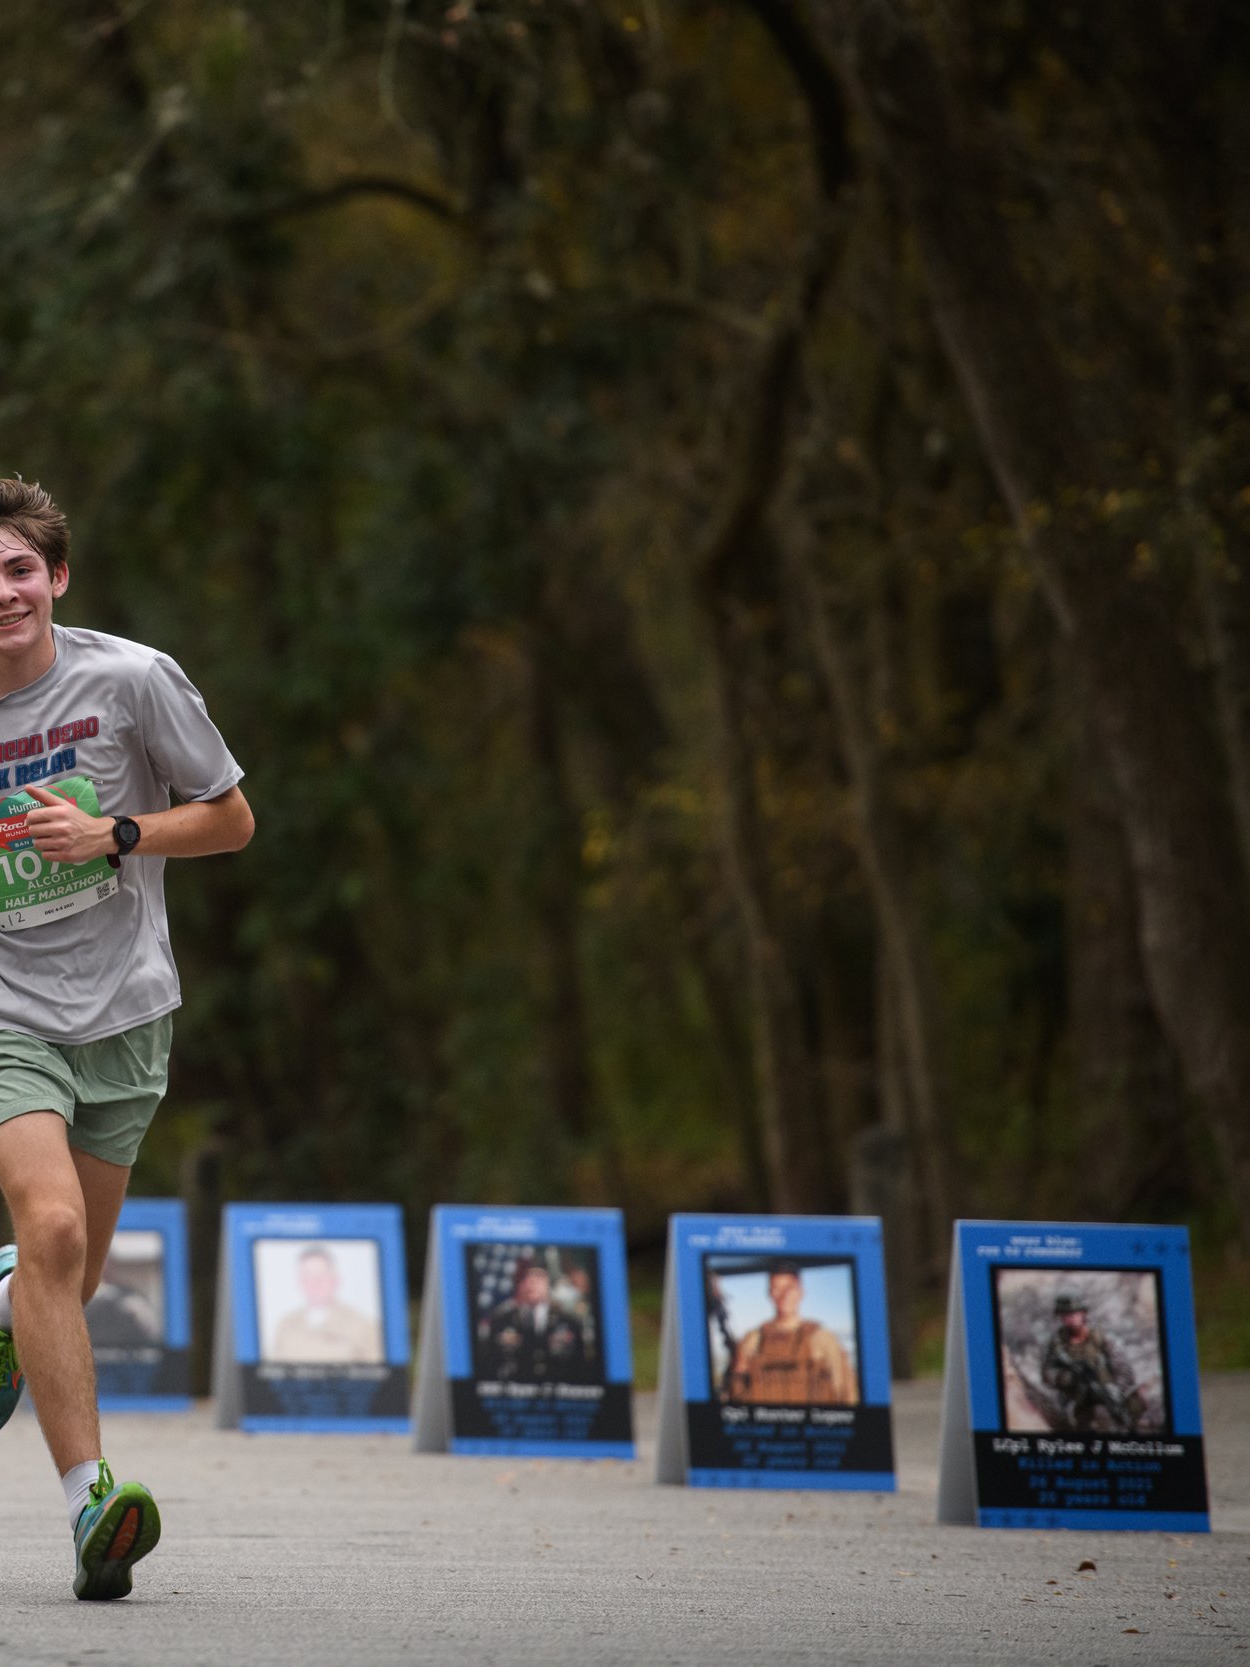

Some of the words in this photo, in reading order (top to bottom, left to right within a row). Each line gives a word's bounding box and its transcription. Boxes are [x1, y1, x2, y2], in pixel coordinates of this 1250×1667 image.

[47, 715, 100, 751] HERO
[14, 746, 77, 787] RELAY
[8, 800, 45, 815] Huma
[5, 894, 36, 909] HALF
[38, 871, 105, 902] MARATHON
[28, 869, 75, 890] ALCOTT
